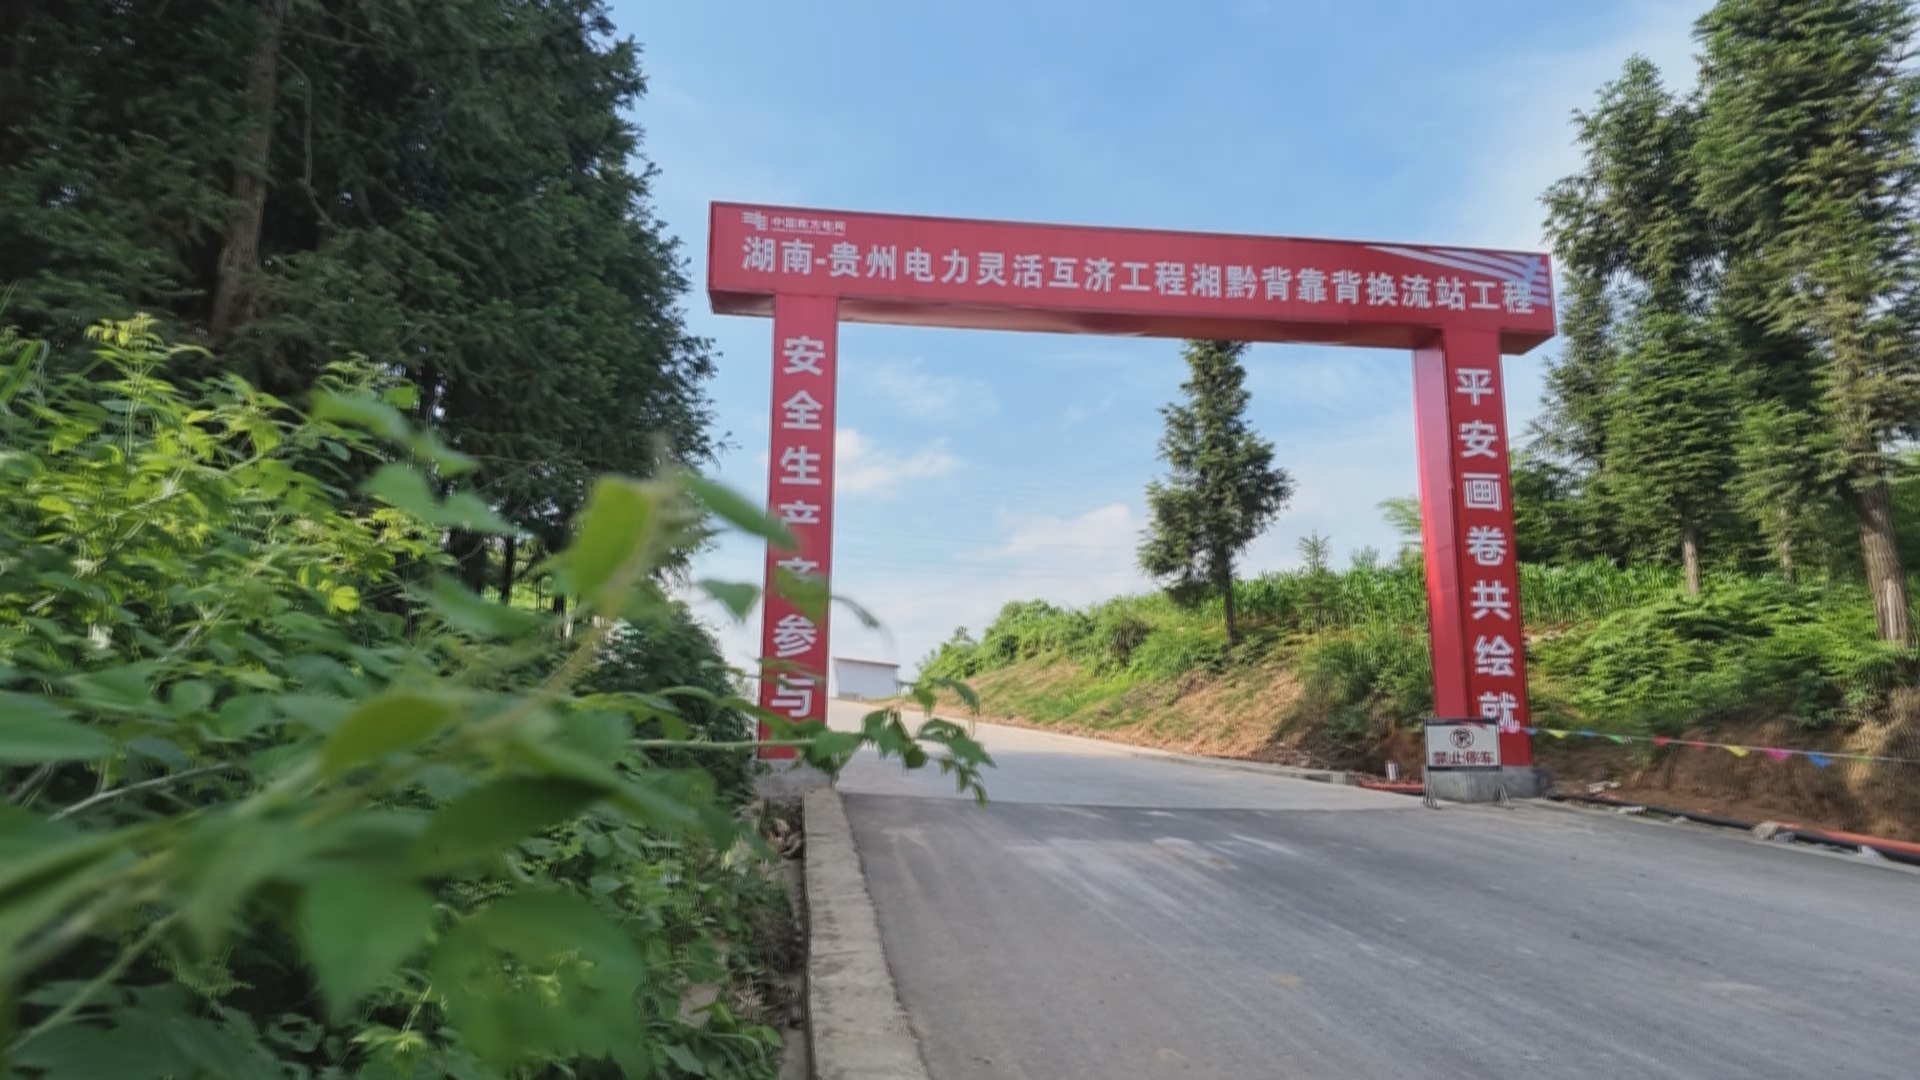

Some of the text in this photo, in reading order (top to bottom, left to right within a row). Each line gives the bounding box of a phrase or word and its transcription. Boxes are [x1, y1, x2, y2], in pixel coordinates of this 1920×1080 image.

[741, 236, 1535, 314] 湖南-贵州电力灵活互济工程湘黔背靠背换流站工程
[1454, 367, 1521, 734] 平安画卷共绘就
[1433, 750, 1495, 766] 禁止停车
